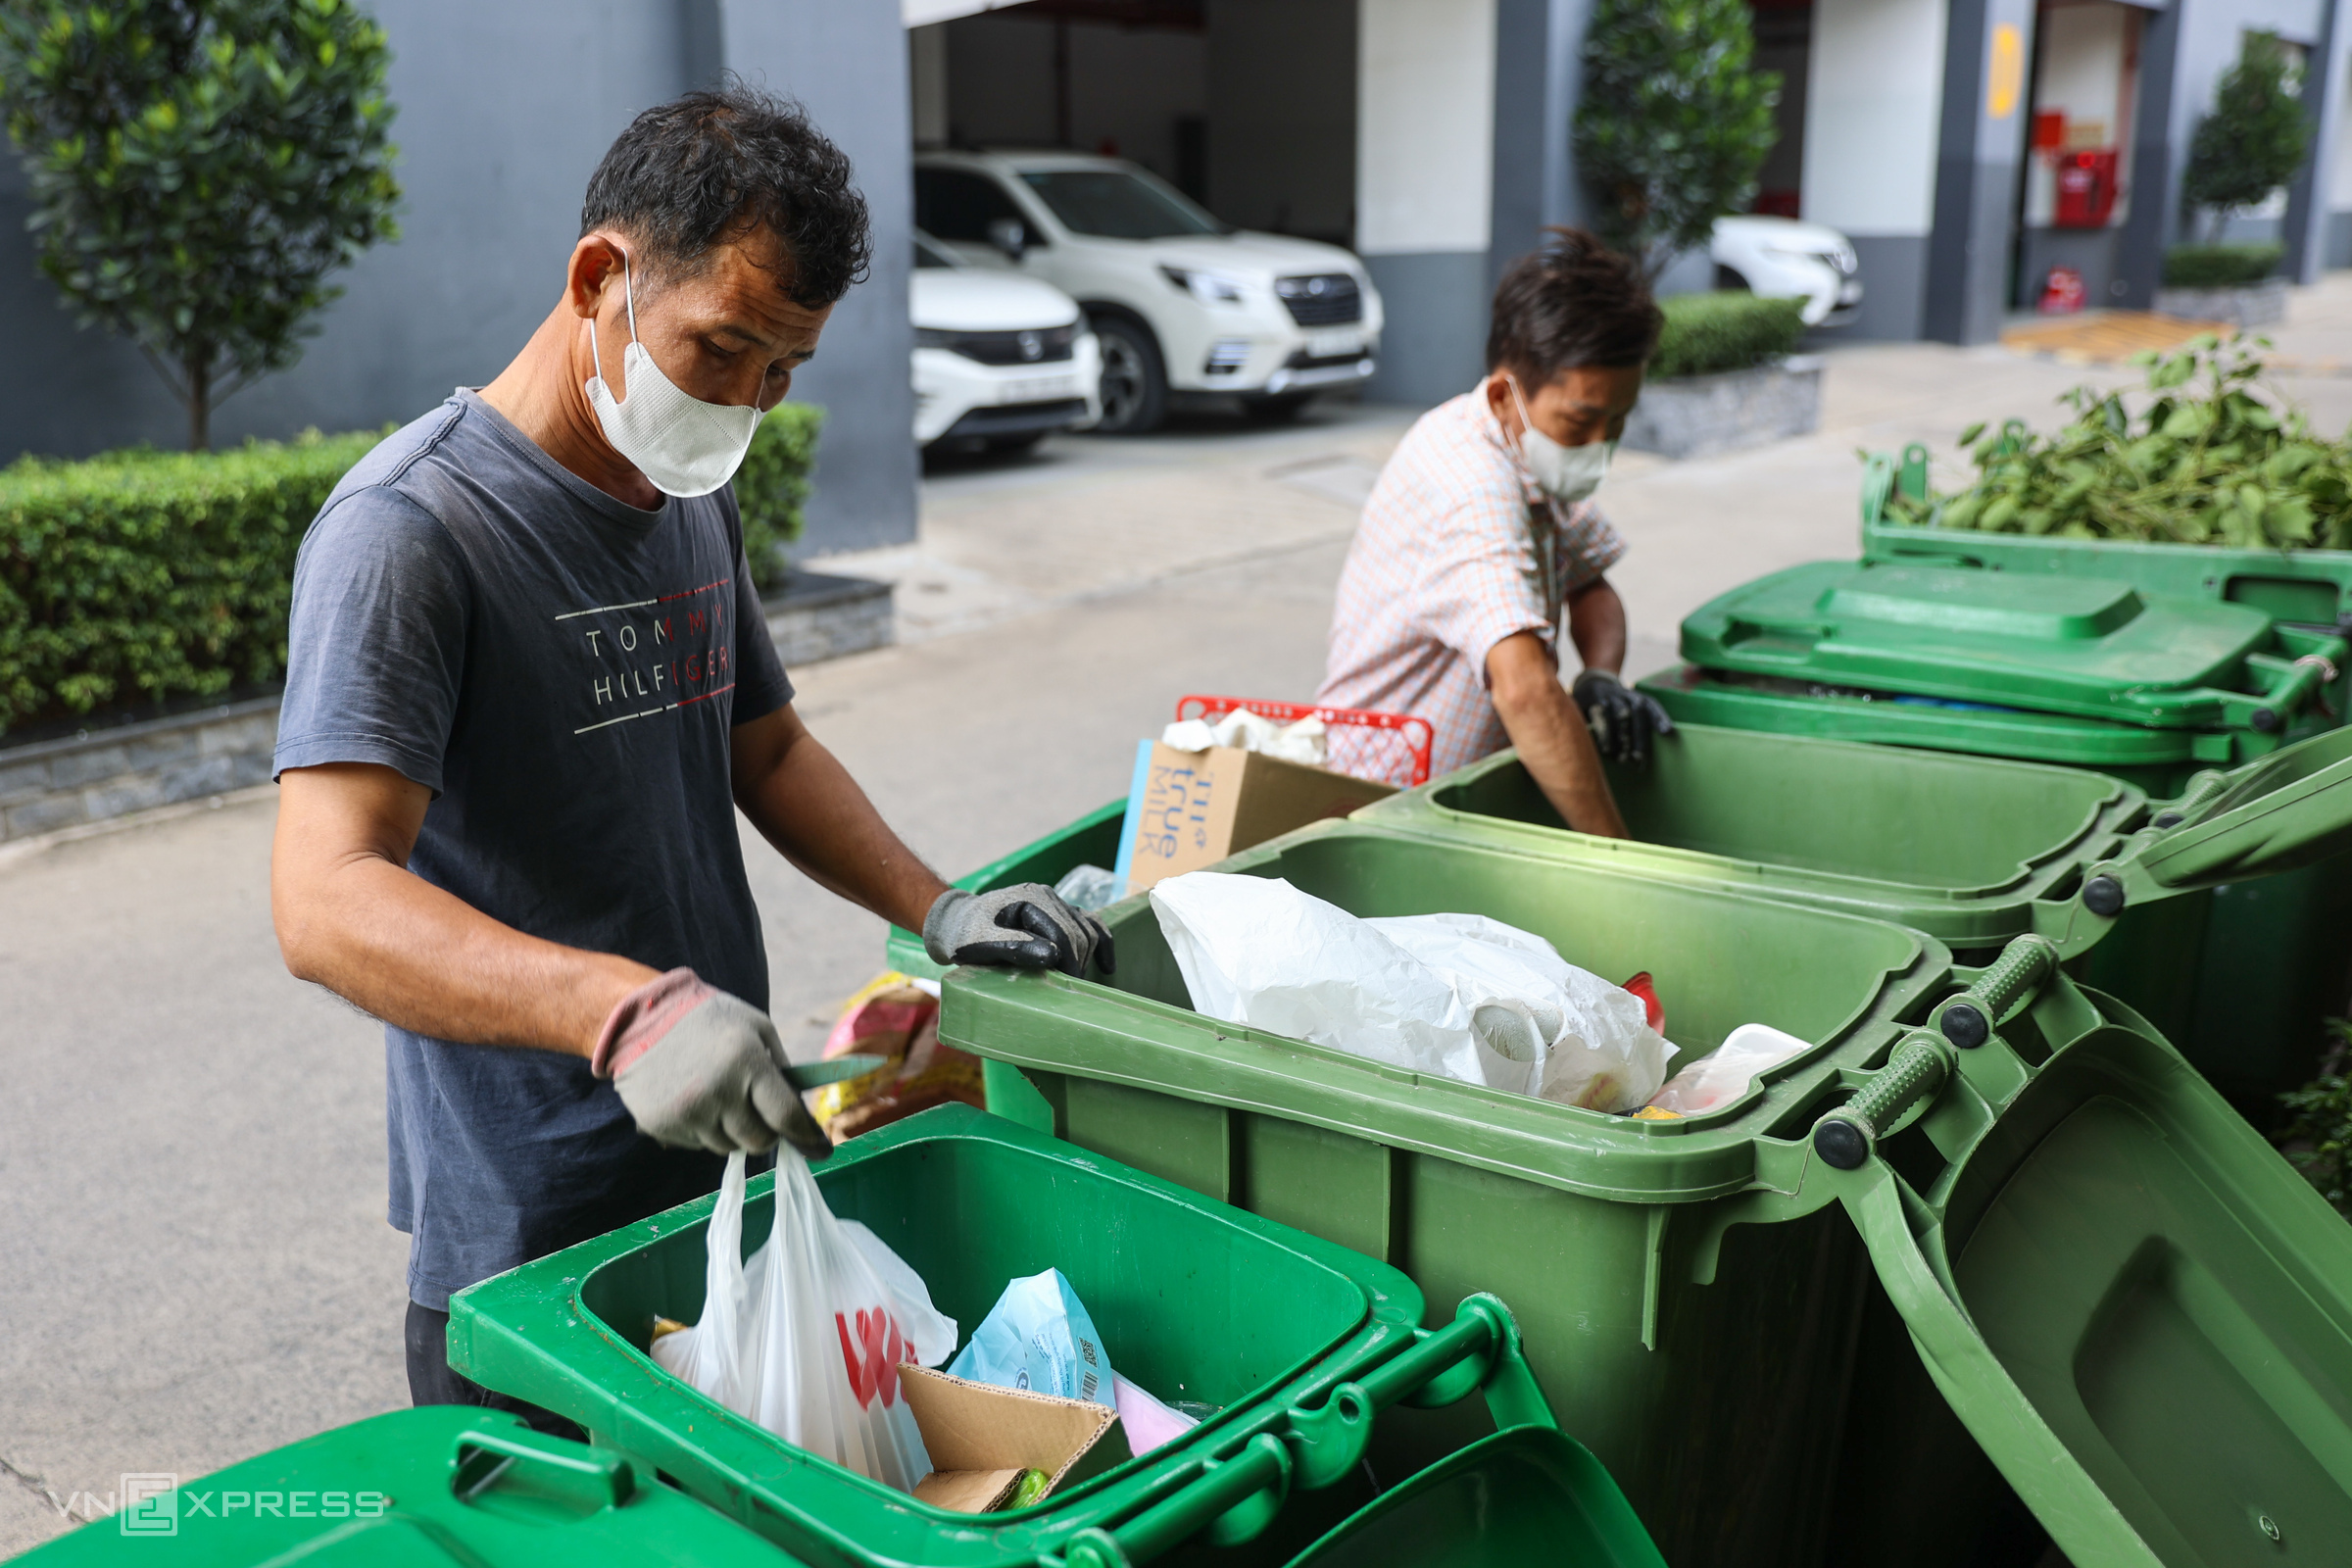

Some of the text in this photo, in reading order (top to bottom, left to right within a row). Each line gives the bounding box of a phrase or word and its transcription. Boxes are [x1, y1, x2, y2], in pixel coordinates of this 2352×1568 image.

[586, 604, 723, 657] TOMMY
[594, 647, 728, 705] HILFIGER
[1138, 765, 1172, 857] MILK
[1157, 765, 1196, 858] true
